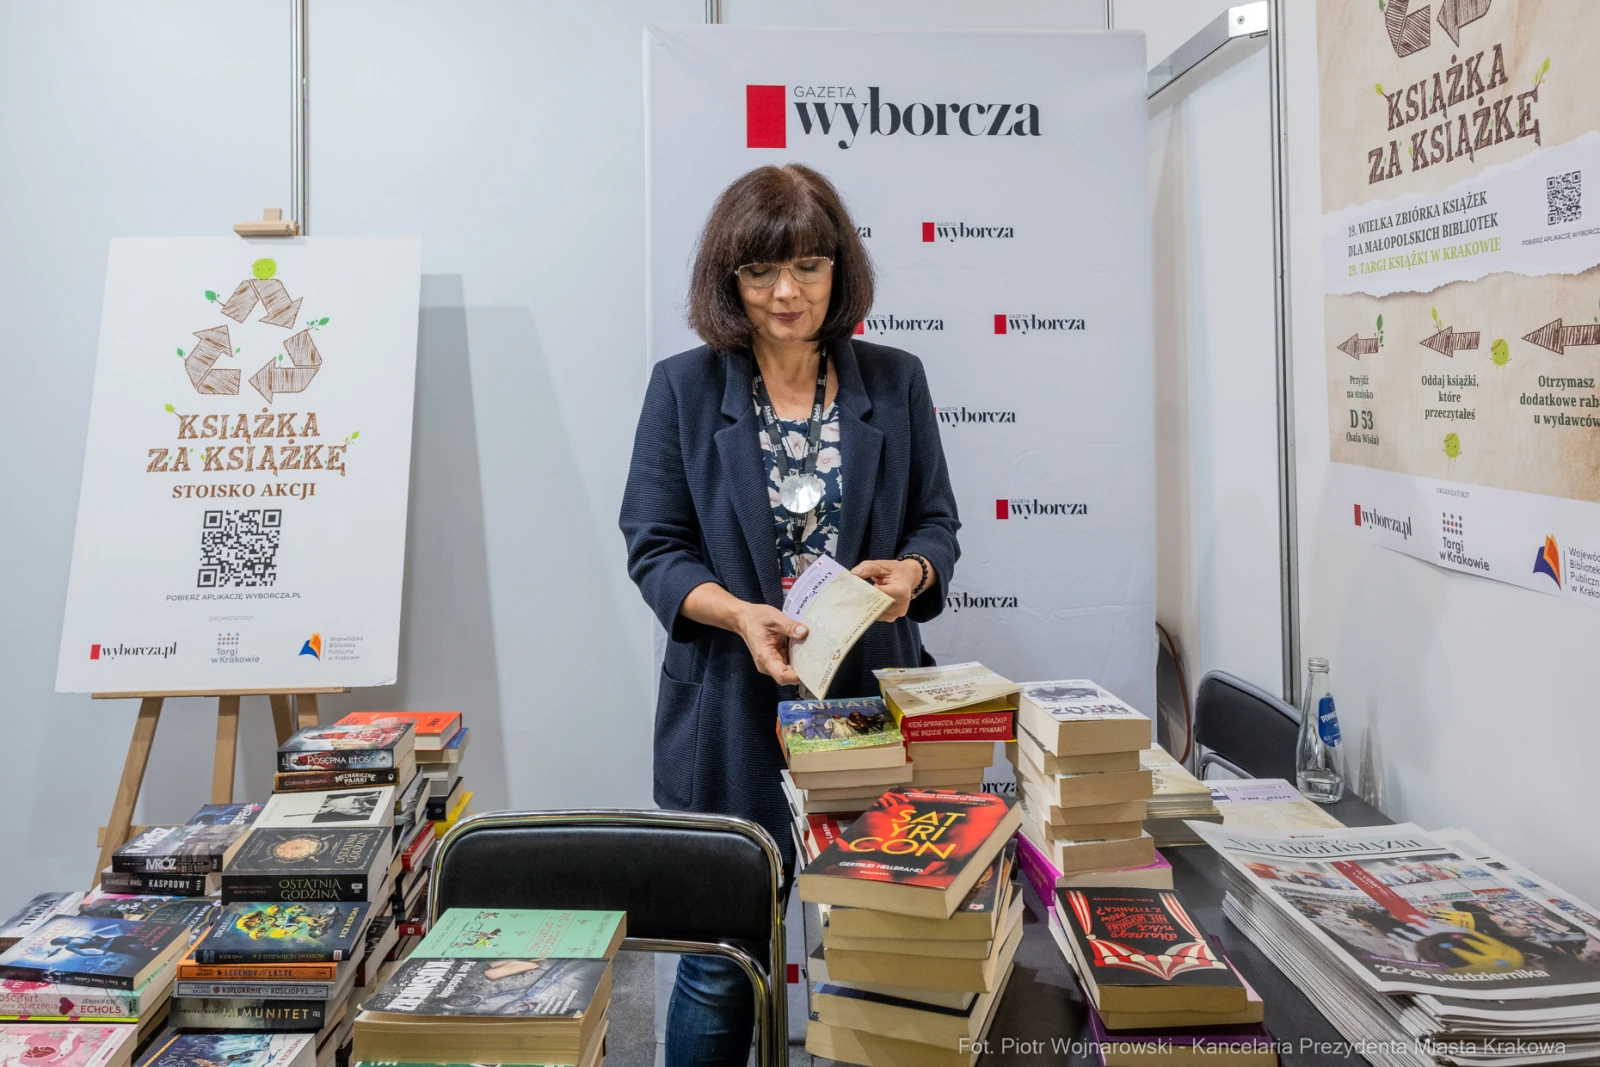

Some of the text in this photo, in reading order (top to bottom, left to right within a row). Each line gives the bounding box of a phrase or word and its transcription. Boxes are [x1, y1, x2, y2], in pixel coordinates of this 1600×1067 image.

[793, 85, 857, 98] GAZETA
[1386, 43, 1508, 132] KSIĄŻKA
[793, 86, 1043, 150] wyborcza
[1368, 88, 1542, 185] ZA KSIĄŻKĘ
[1348, 191, 1488, 238] 19. WIELKA ZBIÓRKA KSIĄŻEK
[937, 222, 1014, 242] wyborcza
[1348, 212, 1499, 257] DLA MAŁOPOLSKICH BIBLIOTEK
[1522, 237, 1543, 246] POBIERZ
[1348, 236, 1502, 277] 29. TARGI KSIĄŻKI W KRAKOWIE
[866, 314, 944, 335] wyborcza
[1008, 314, 1085, 335] wyborcza
[1349, 375, 1370, 387] Przyjdź
[1421, 374, 1480, 389] Oddaj książki,
[1538, 375, 1595, 391] Otrzymasz
[1346, 388, 1374, 400] na stoisko
[1438, 391, 1462, 403] które
[1520, 393, 1577, 407] dodatkowe
[938, 407, 1016, 427] wyborcza
[1350, 409, 1374, 430] D 53
[1424, 408, 1476, 421] przeczytałeś
[1534, 414, 1540, 424] u
[177, 407, 320, 444] KSIĄŻKA
[1346, 431, 1379, 447] (hala Wisła)
[146, 438, 348, 477] ZA KSIĄŻKĘ
[172, 482, 317, 500] STOISKO AKCJI
[1437, 487, 1470, 499] ORGANIZATORZY
[1010, 499, 1088, 520] wyborcza
[1361, 508, 1413, 540] wyborcza.pl
[1442, 536, 1464, 552] Targi
[1439, 551, 1490, 571] w Krakowie
[201, 593, 243, 602] APLIKACJĘ
[245, 592, 302, 600] WYBORCZA.PL
[102, 642, 178, 660] wyborcza.pl
[216, 647, 239, 657] Targi
[219, 655, 260, 663] Krakowie
[790, 699, 879, 711] ANHAR
[908, 719, 922, 728] KTOŚ
[982, 716, 1008, 725] KSIĄŻKI?
[307, 754, 346, 765] POSĘPNA
[335, 772, 377, 783] MECHANICZNE
[891, 809, 966, 827] SAT
[889, 822, 946, 842] YRI
[849, 836, 956, 860] CON
[146, 856, 177, 870] MRÓZ
[839, 861, 923, 874] GERTRUD HELLBRAND
[148, 879, 191, 889] KASPROWY
[278, 879, 343, 891] OSTATNIA
[280, 889, 341, 901] GODZINA
[1373, 963, 1551, 984] 22-25 października
[17, 1002, 58, 1010] zdarzenia
[80, 1005, 122, 1014] ECHOLS
[223, 1008, 309, 1020] IMMUNITET
